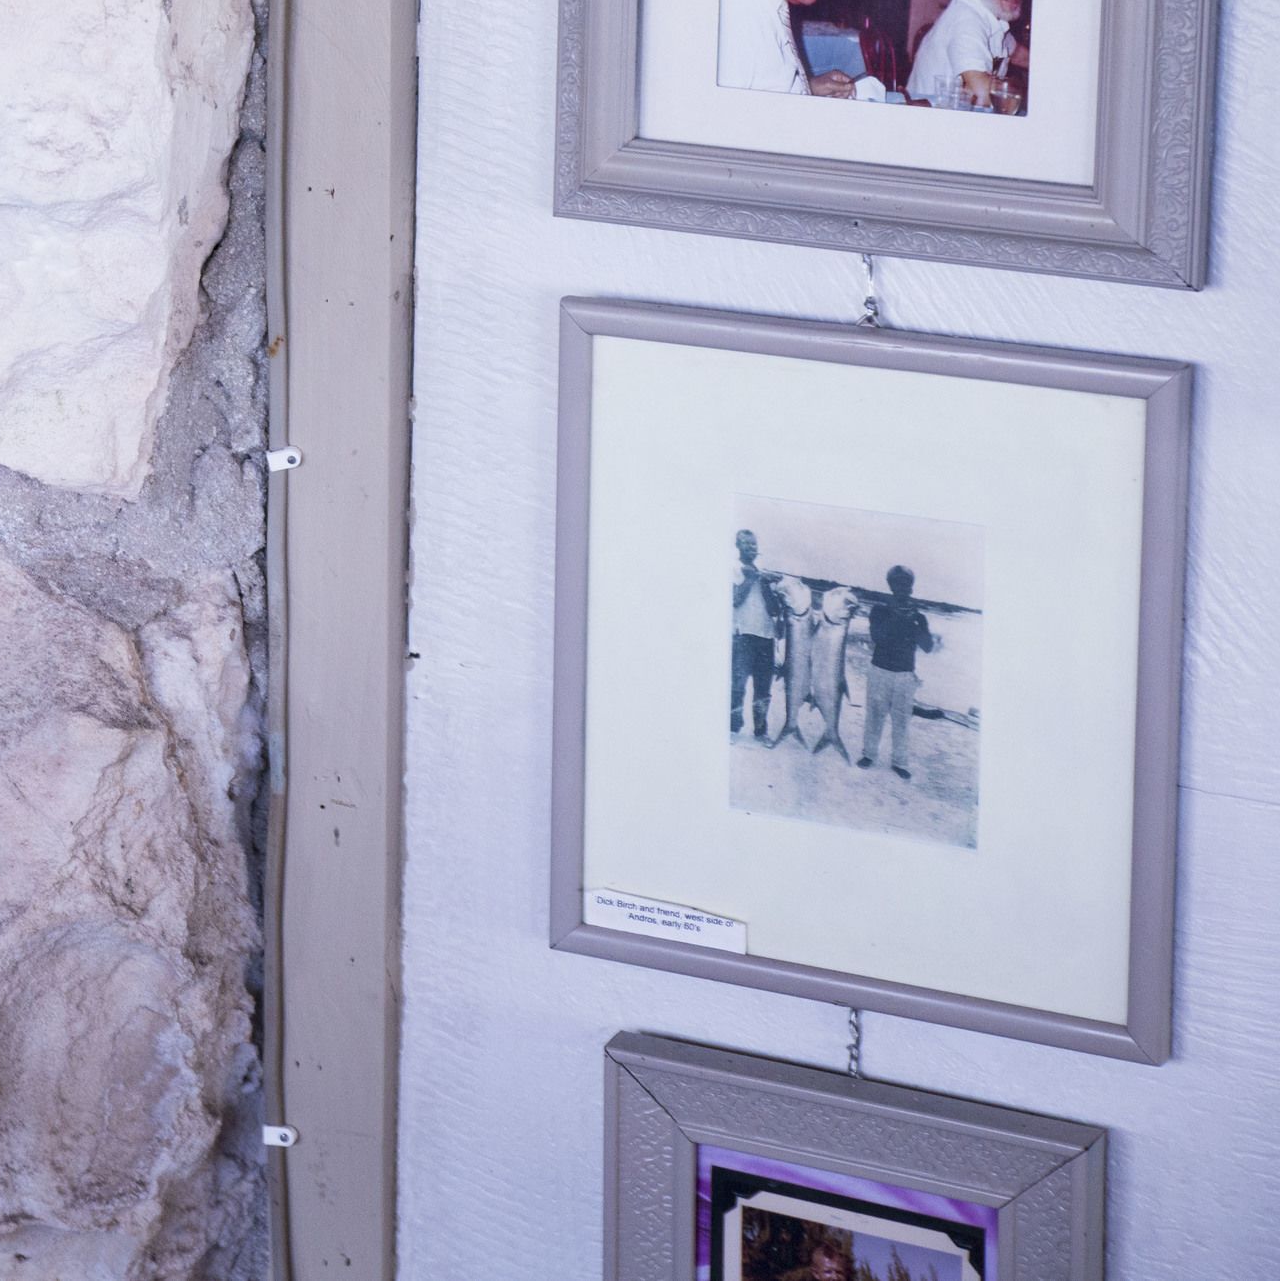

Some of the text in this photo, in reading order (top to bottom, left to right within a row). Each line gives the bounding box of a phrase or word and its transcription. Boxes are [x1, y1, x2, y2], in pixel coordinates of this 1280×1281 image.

[597, 896, 615, 907] Dick
[617, 900, 637, 910] Birch
[640, 905, 655, 913] and
[684, 913, 704, 921] west
[706, 917, 723, 927] side
[662, 920, 681, 930] early
